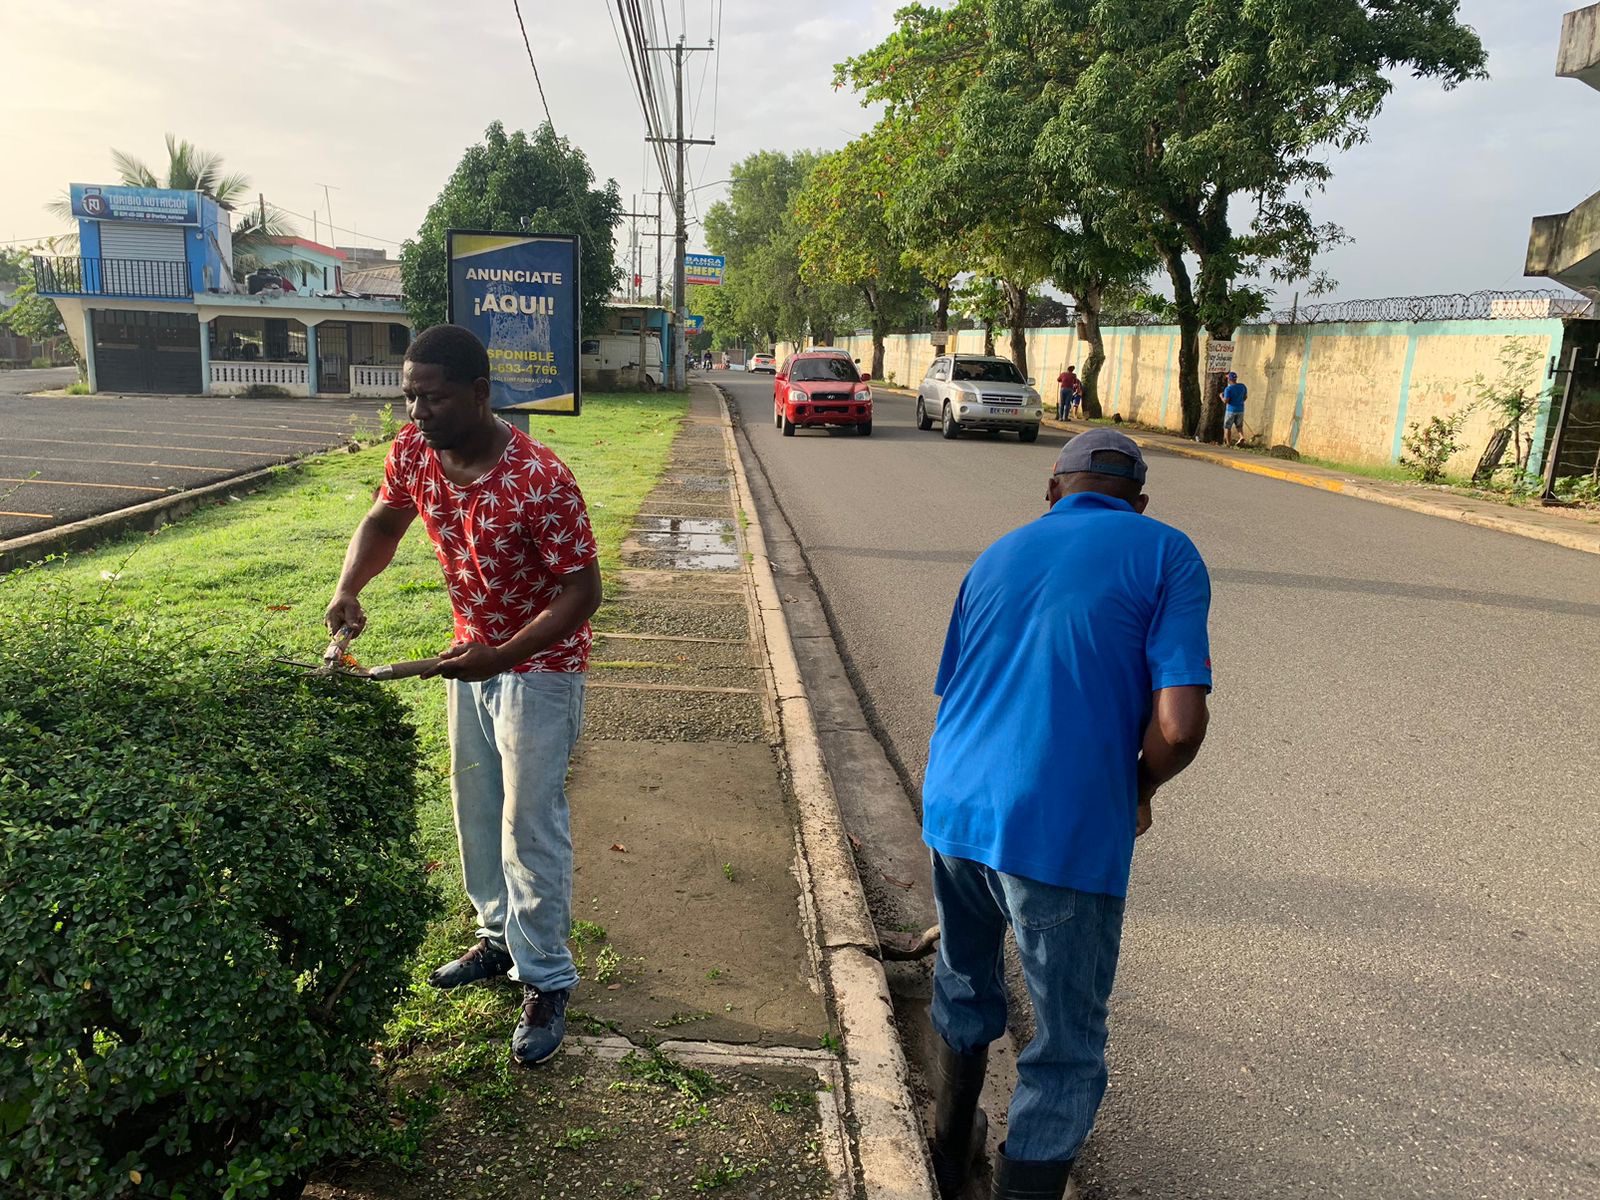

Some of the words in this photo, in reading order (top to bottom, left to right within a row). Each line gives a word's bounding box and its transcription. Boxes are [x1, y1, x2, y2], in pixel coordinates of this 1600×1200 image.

[685, 256, 722, 264] BANCA
[465, 268, 562, 285] ANUNCIATE
[685, 265, 721, 276] CHEPE
[474, 293, 554, 316] ¡AQUI!
[486, 348, 554, 362] SPONIBLE
[489, 363, 558, 375] -693-4766
